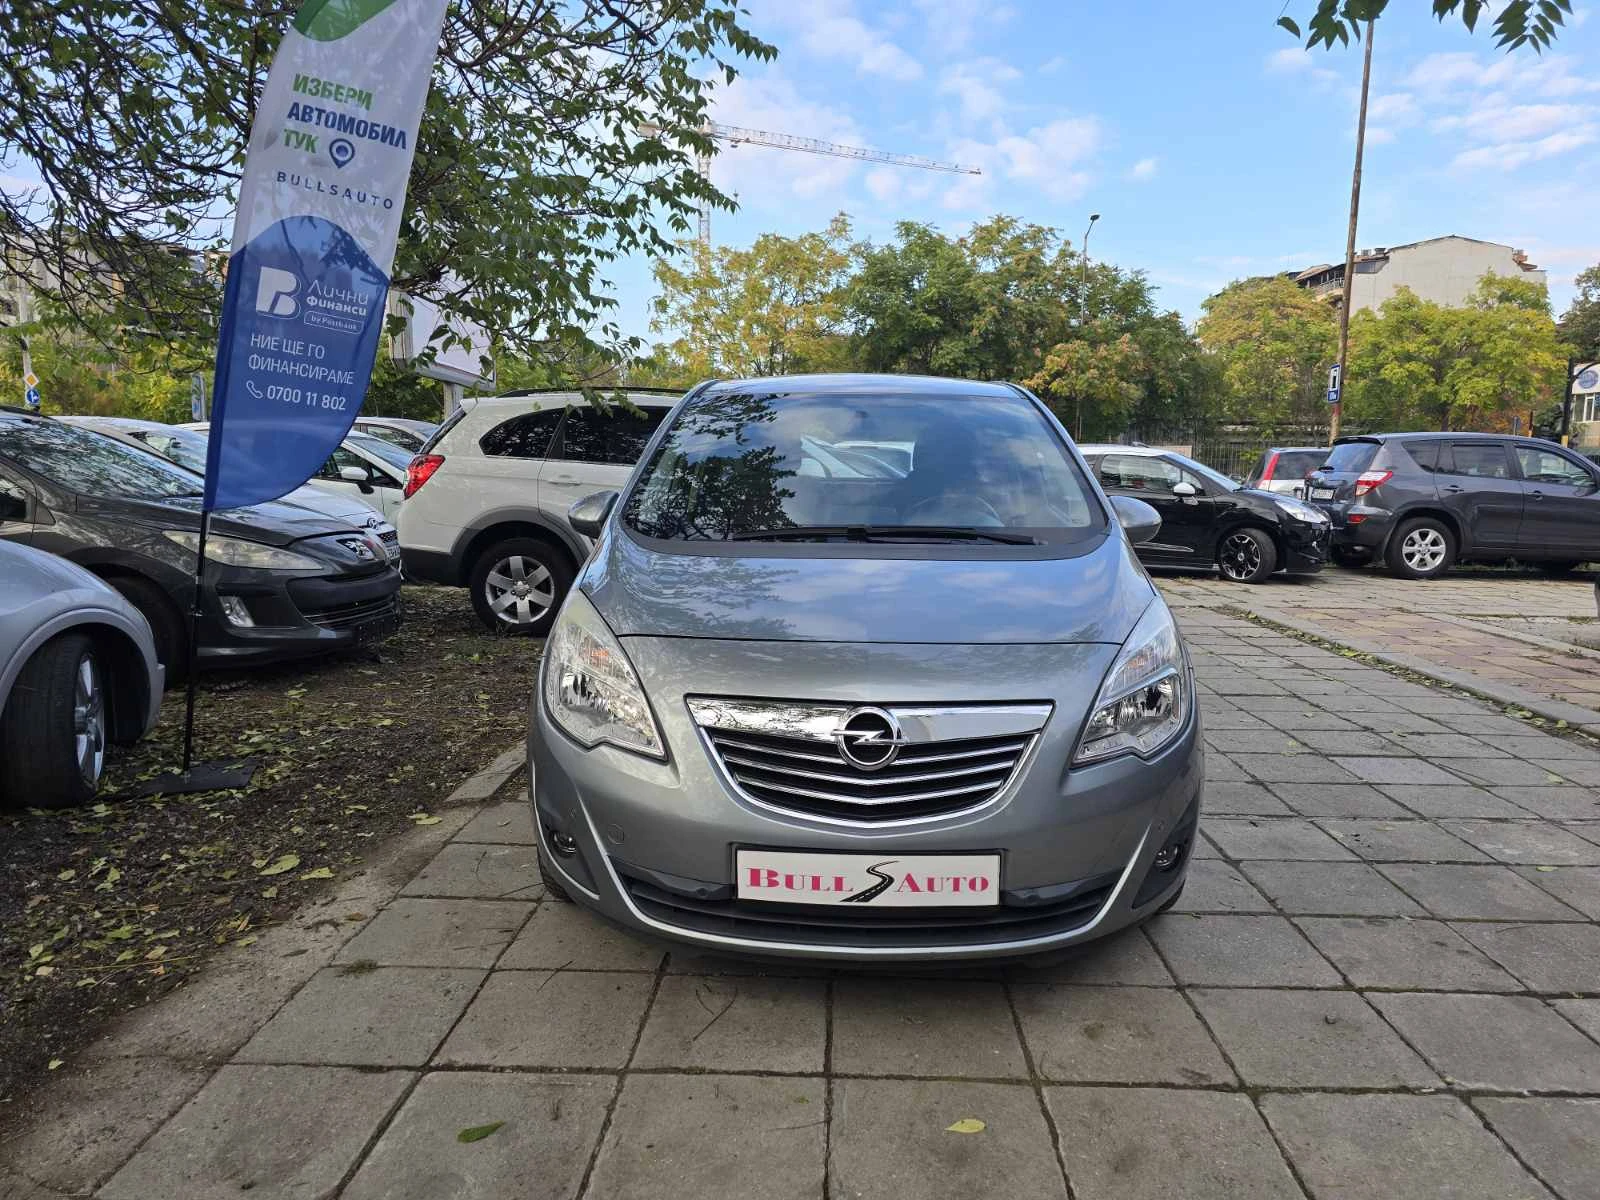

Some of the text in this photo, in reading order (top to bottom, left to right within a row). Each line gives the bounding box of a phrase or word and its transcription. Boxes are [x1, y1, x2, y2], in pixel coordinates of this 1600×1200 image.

[293, 73, 373, 111] ИЗБЕРИ
[287, 102, 407, 149] АВТОМОБИЛ
[284, 128, 319, 153] ТУК
[277, 171, 393, 209] BULLSAUTO
[308, 279, 369, 305] Лични
[250, 333, 325, 360] НИЕ ЩЕ ГО
[248, 353, 355, 385] ФИНАНСИРАМЕ
[267, 385, 346, 411] 0700 11 802
